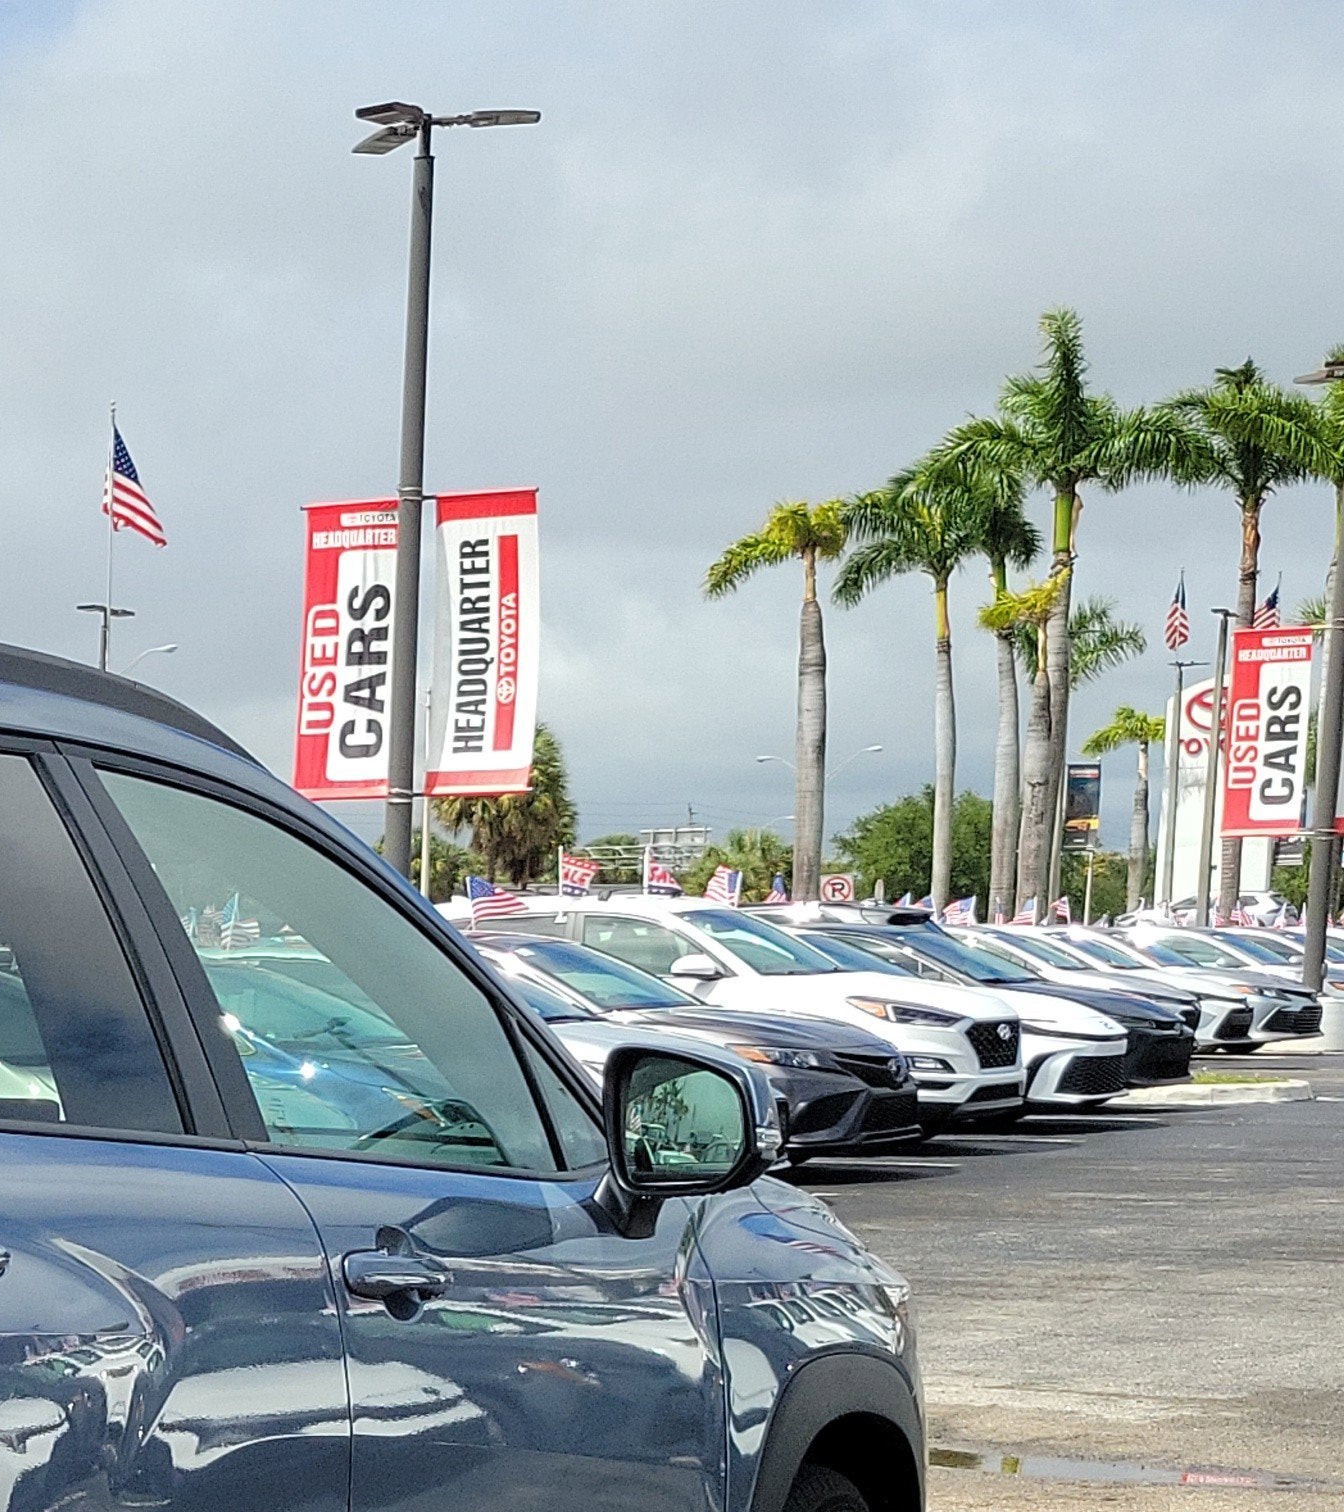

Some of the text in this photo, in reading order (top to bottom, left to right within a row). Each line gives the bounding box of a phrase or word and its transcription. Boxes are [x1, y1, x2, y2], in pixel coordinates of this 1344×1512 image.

[312, 528, 397, 549] HEADQUARTER
[359, 513, 397, 523] TOYOTA
[305, 608, 339, 730] USED
[339, 584, 391, 759] CARS
[452, 538, 495, 754] HEADQUARTER
[499, 592, 518, 677] TOYOTA
[1238, 647, 1307, 662] HEADQUARTER
[1231, 703, 1261, 788] USED
[1259, 685, 1303, 806] CARS
